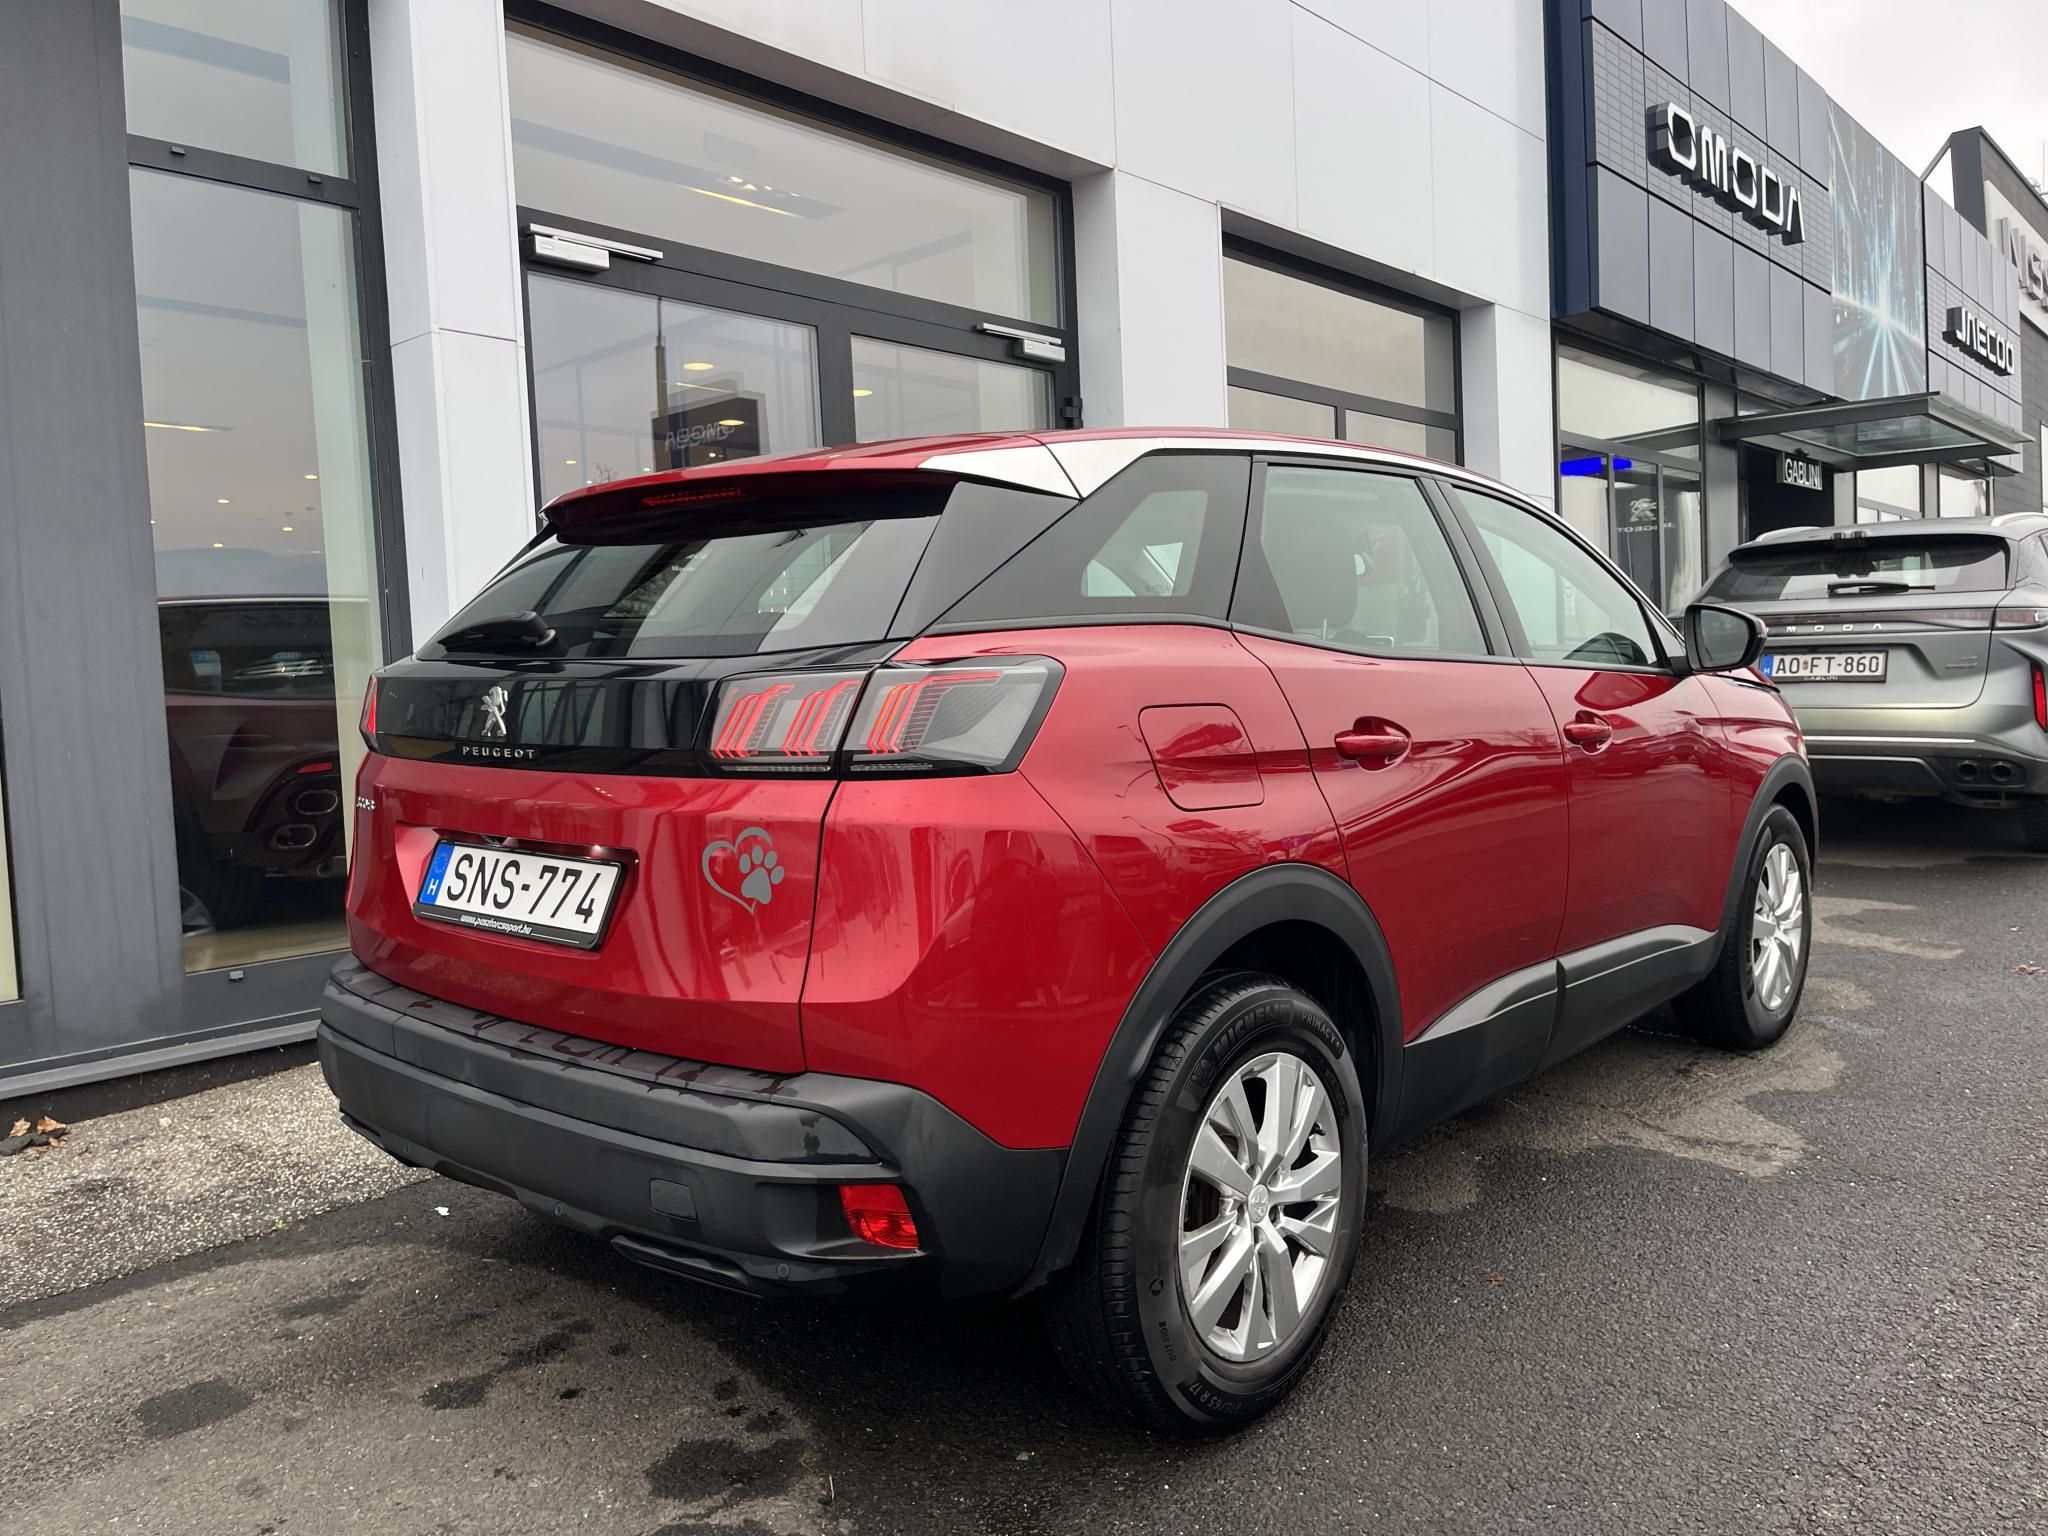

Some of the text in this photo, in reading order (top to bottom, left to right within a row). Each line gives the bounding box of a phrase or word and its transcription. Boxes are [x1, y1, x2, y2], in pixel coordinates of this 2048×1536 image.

[1660, 102, 1805, 242] OMODA
[1952, 306, 2015, 375] JAECOO
[1785, 458, 1821, 488] GABLINI
[1766, 623, 1882, 634] MODA
[1776, 657, 1800, 675] AO
[1810, 656, 1880, 674] FT-860
[462, 746, 535, 759] PEUGEOT
[426, 853, 602, 924] H SNS-774
[1213, 1003, 1291, 1059] MICHELIN
[1302, 1011, 1337, 1044] PRIMACY
[1187, 1380, 1200, 1393] 17
[1200, 1389, 1211, 1401] R
